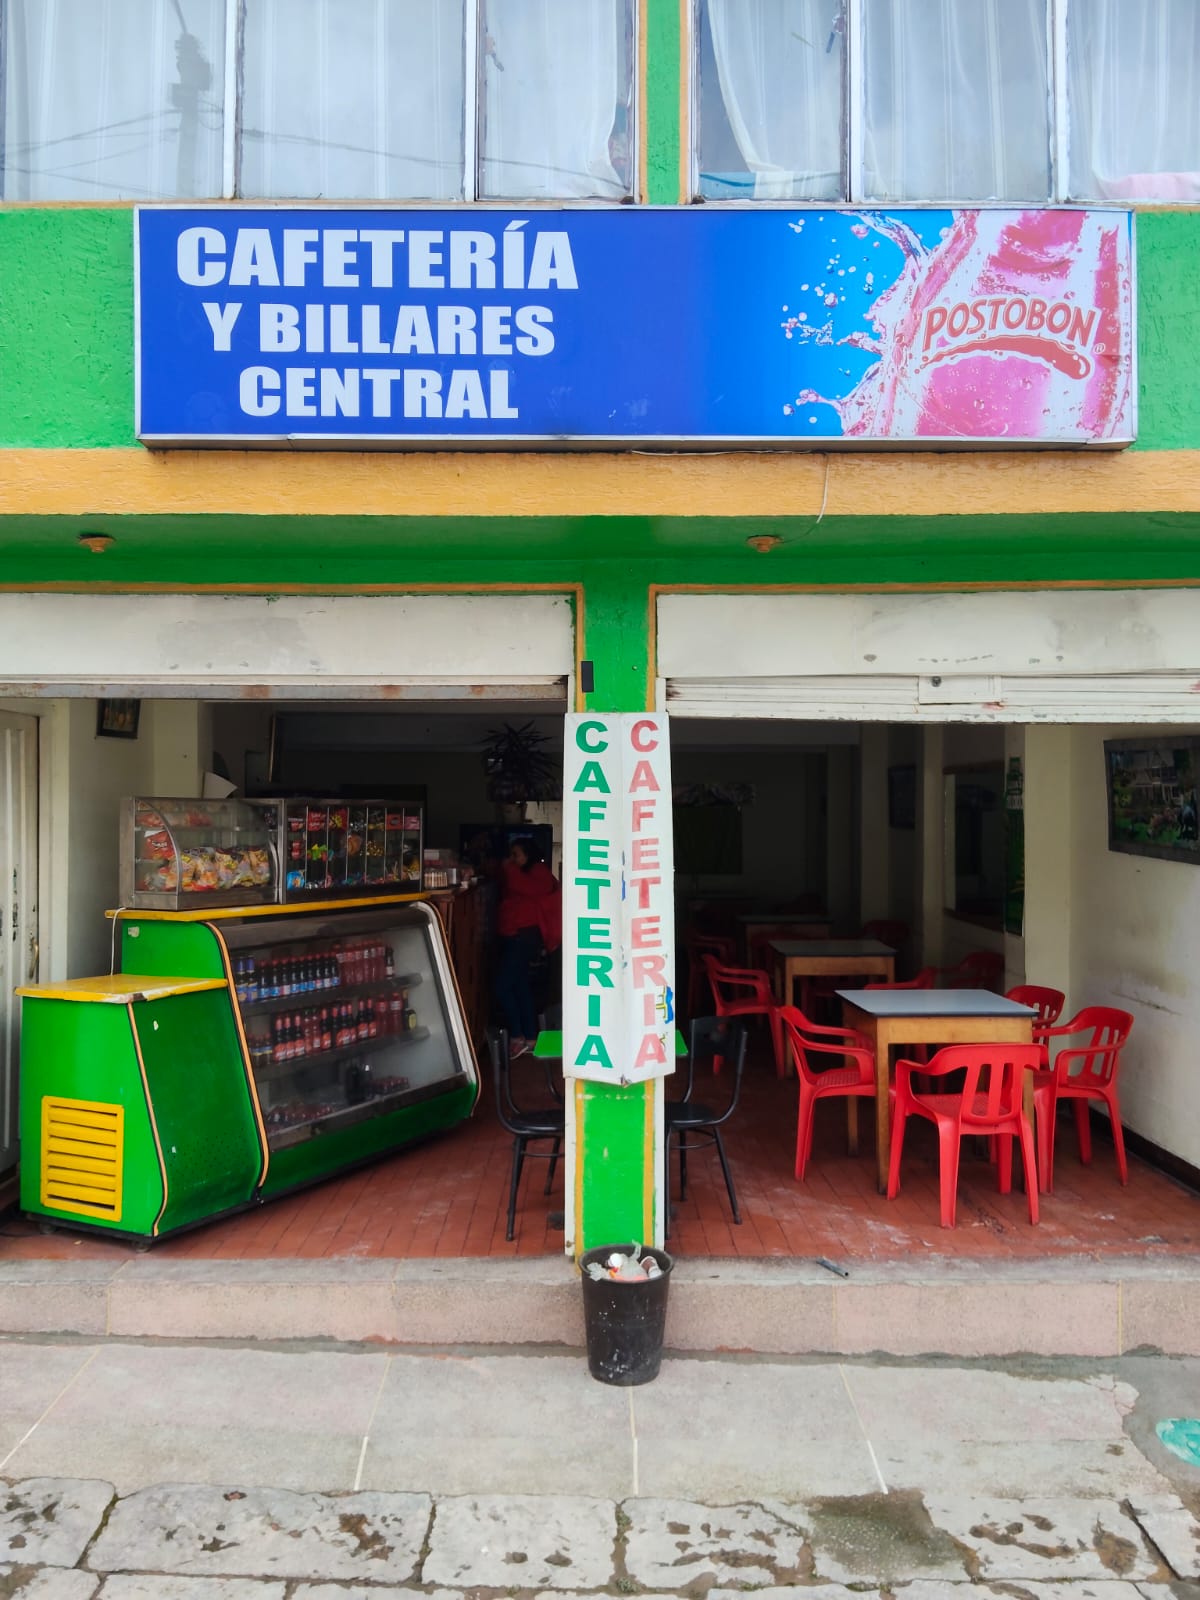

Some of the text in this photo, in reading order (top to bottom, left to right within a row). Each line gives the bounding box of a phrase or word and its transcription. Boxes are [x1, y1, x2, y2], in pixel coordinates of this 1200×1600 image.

[176, 219, 579, 290] CAFETERÍA
[202, 302, 556, 356] Y BILLARES
[923, 299, 1096, 351] POSTOBON
[239, 366, 518, 419] CENTRAL
[573, 720, 615, 1068] CAFETERIA
[629, 720, 668, 1068] CAFETERIA
